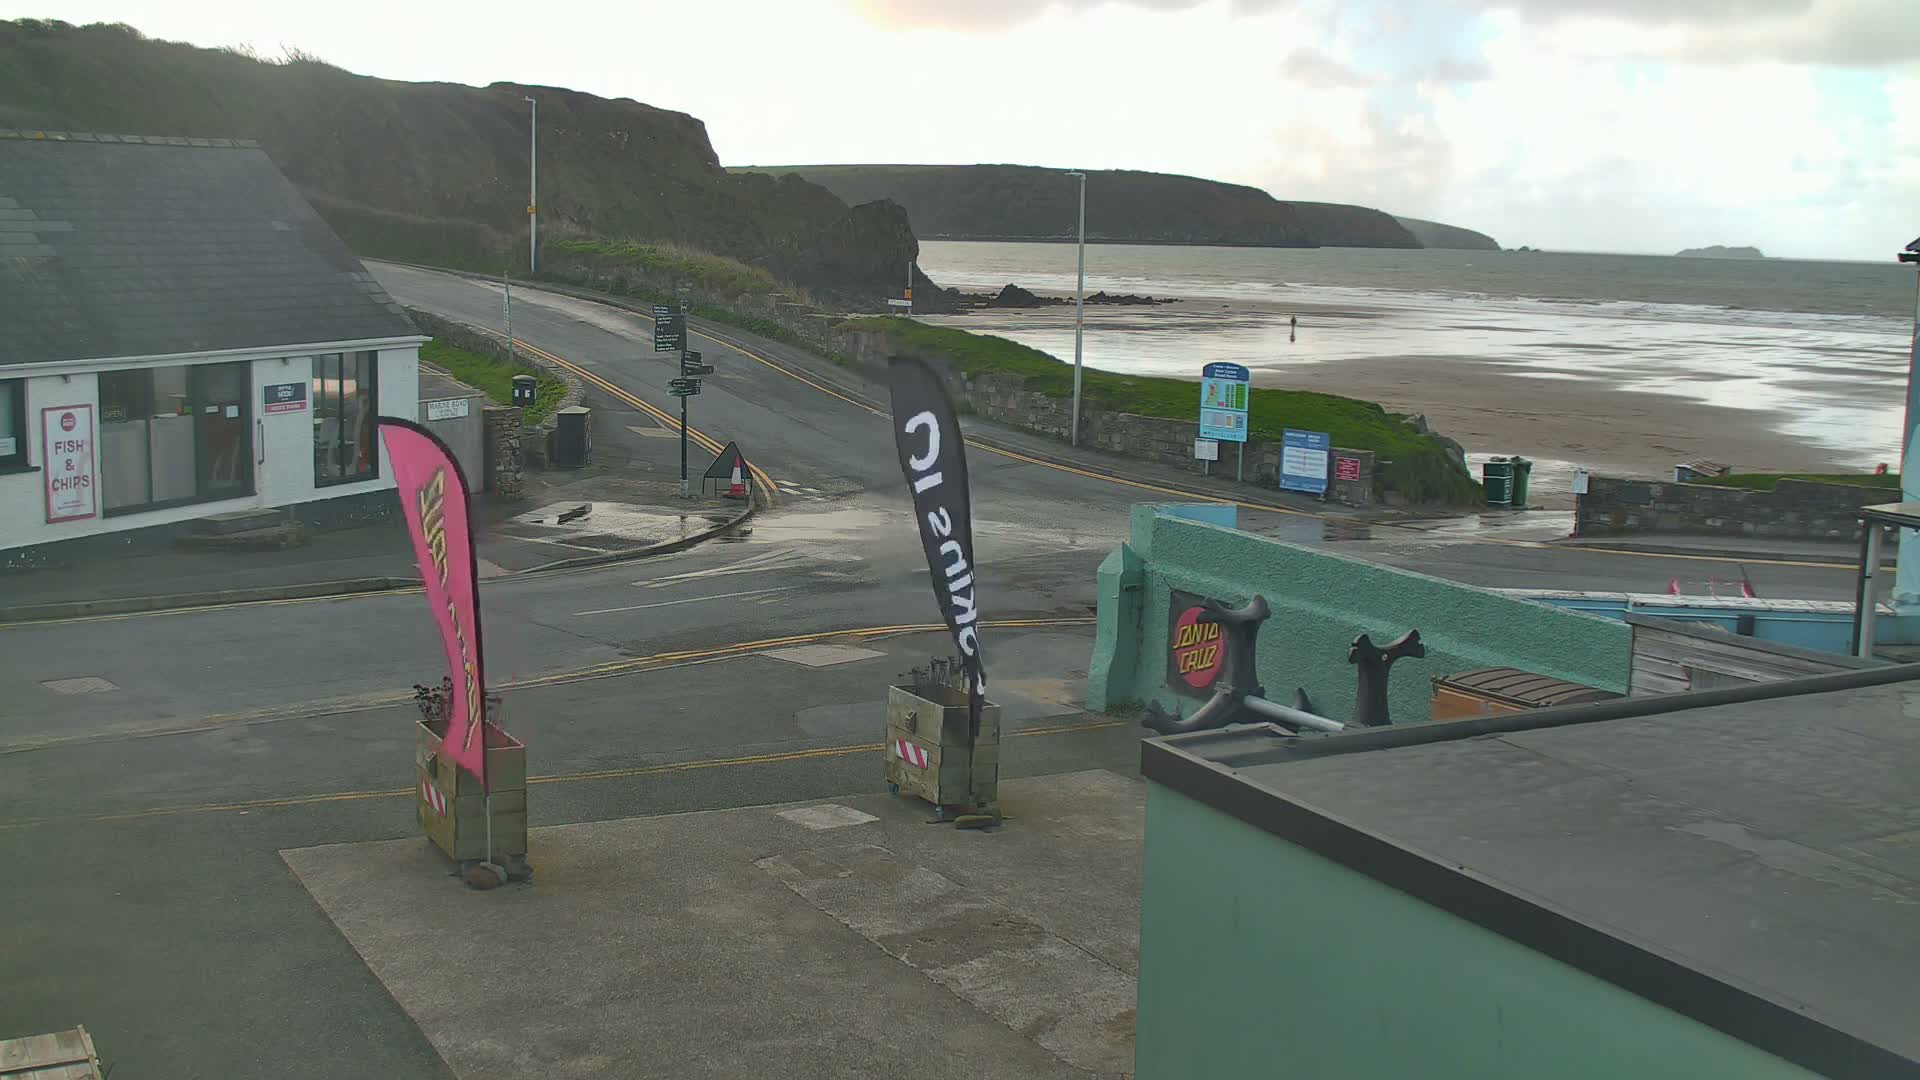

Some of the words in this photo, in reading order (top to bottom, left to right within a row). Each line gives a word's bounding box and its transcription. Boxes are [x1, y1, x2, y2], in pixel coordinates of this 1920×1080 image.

[54, 440, 84, 455] FISH
[65, 459, 75, 471] &
[51, 475, 90, 492] CHIPS
[1180, 645, 1217, 674] CRUZ
